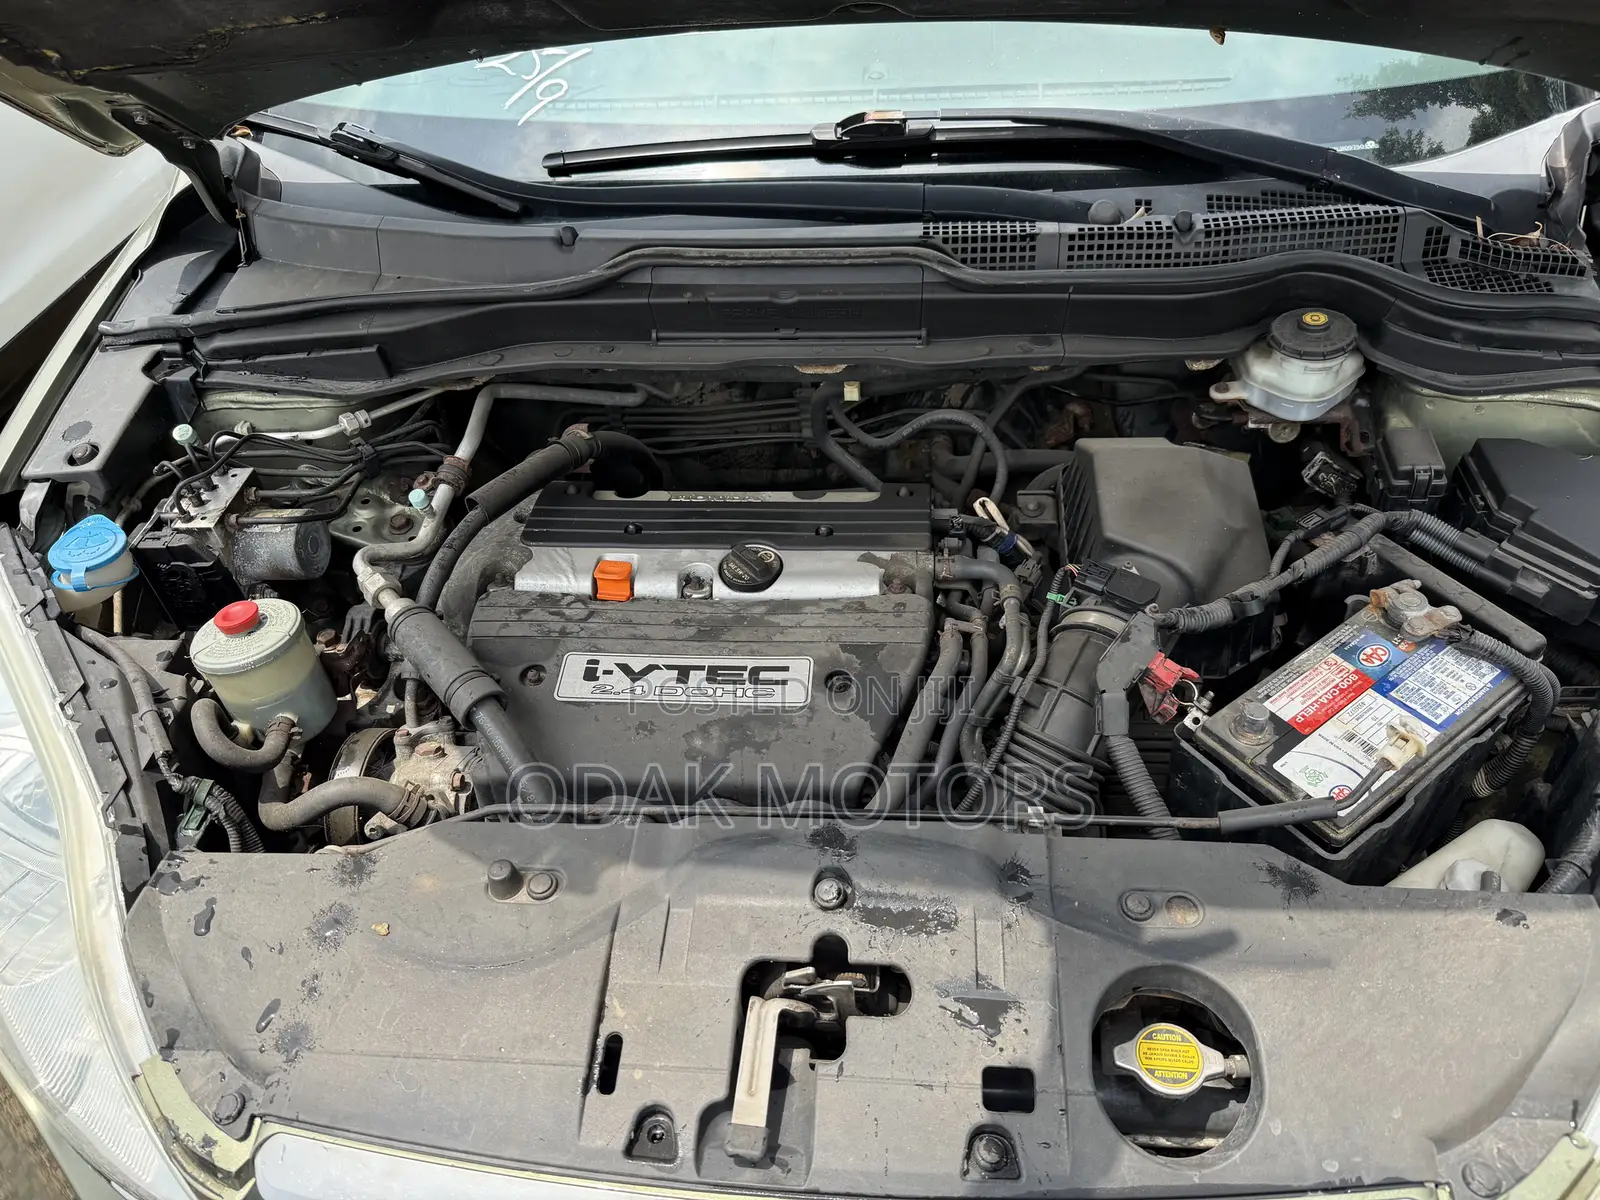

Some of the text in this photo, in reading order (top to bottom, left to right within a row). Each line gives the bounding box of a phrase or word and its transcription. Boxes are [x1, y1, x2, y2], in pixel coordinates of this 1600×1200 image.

[1360, 646, 1388, 664] CAA
[583, 658, 790, 686] i-VTEC
[591, 684, 776, 699] 2.4 DOHC
[1295, 672, 1358, 723] 800-CAA-HELP
[1152, 1033, 1181, 1041] CAUTION
[1154, 1070, 1188, 1079] ATTENTION
